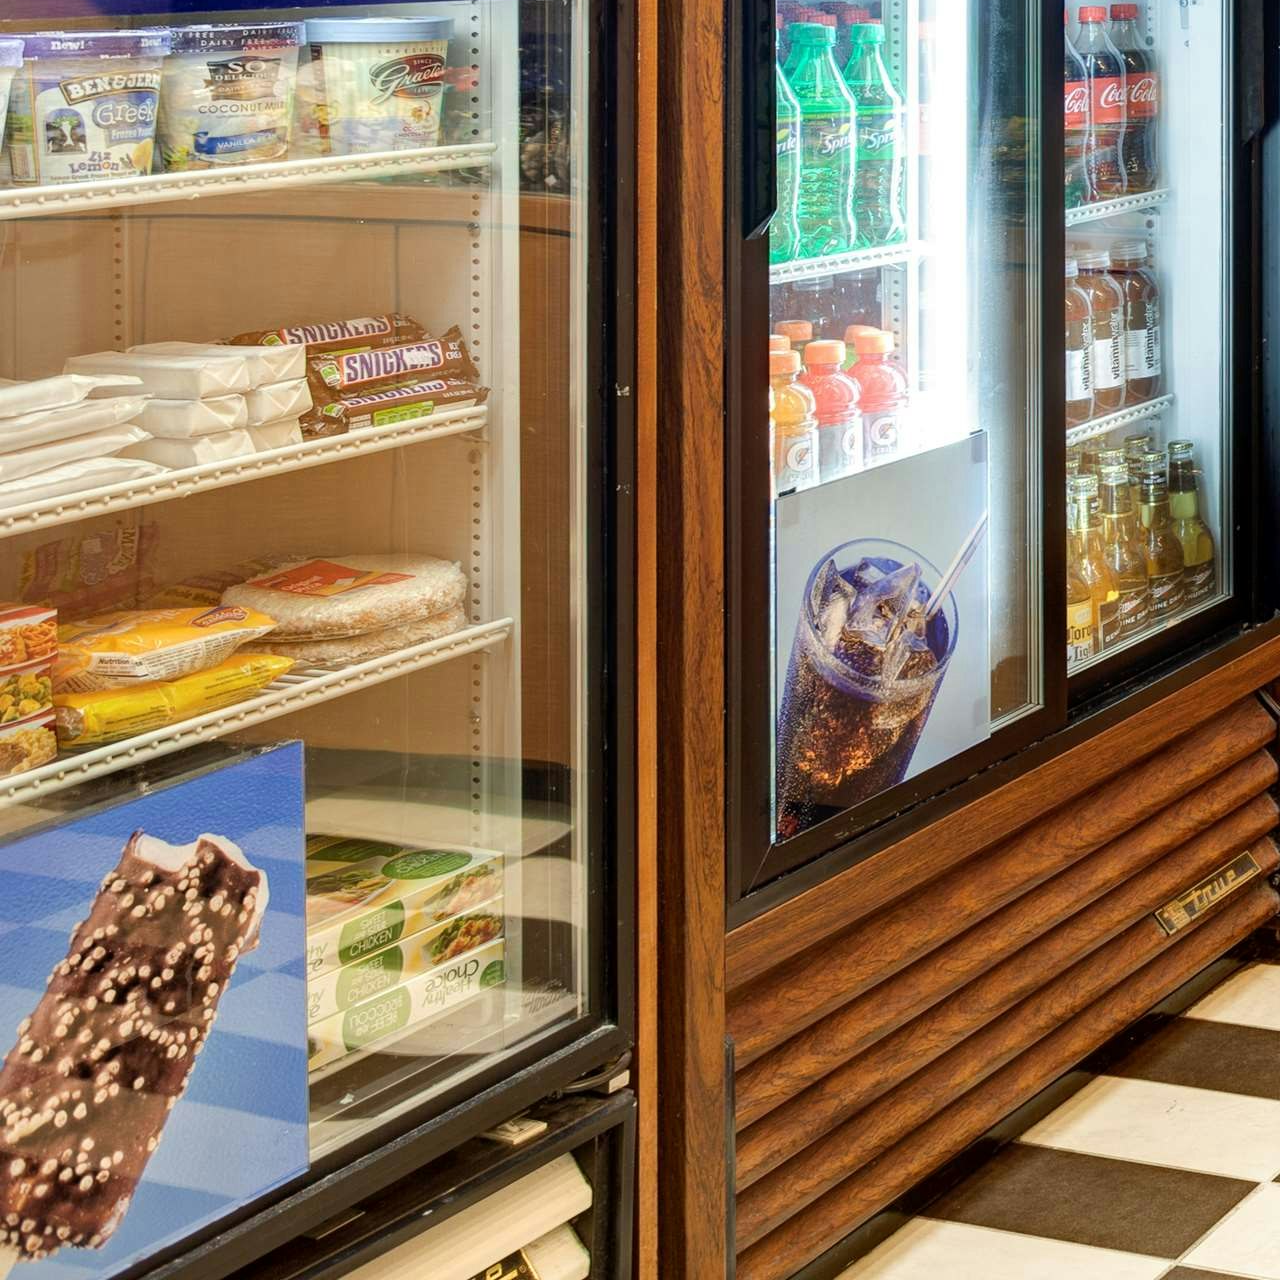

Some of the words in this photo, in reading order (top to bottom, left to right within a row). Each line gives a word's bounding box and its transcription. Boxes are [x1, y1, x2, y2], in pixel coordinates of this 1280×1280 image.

[228, 61, 266, 74] SO
[198, 102, 263, 115] COCONUT
[1144, 302, 1155, 369] vitaminwater
